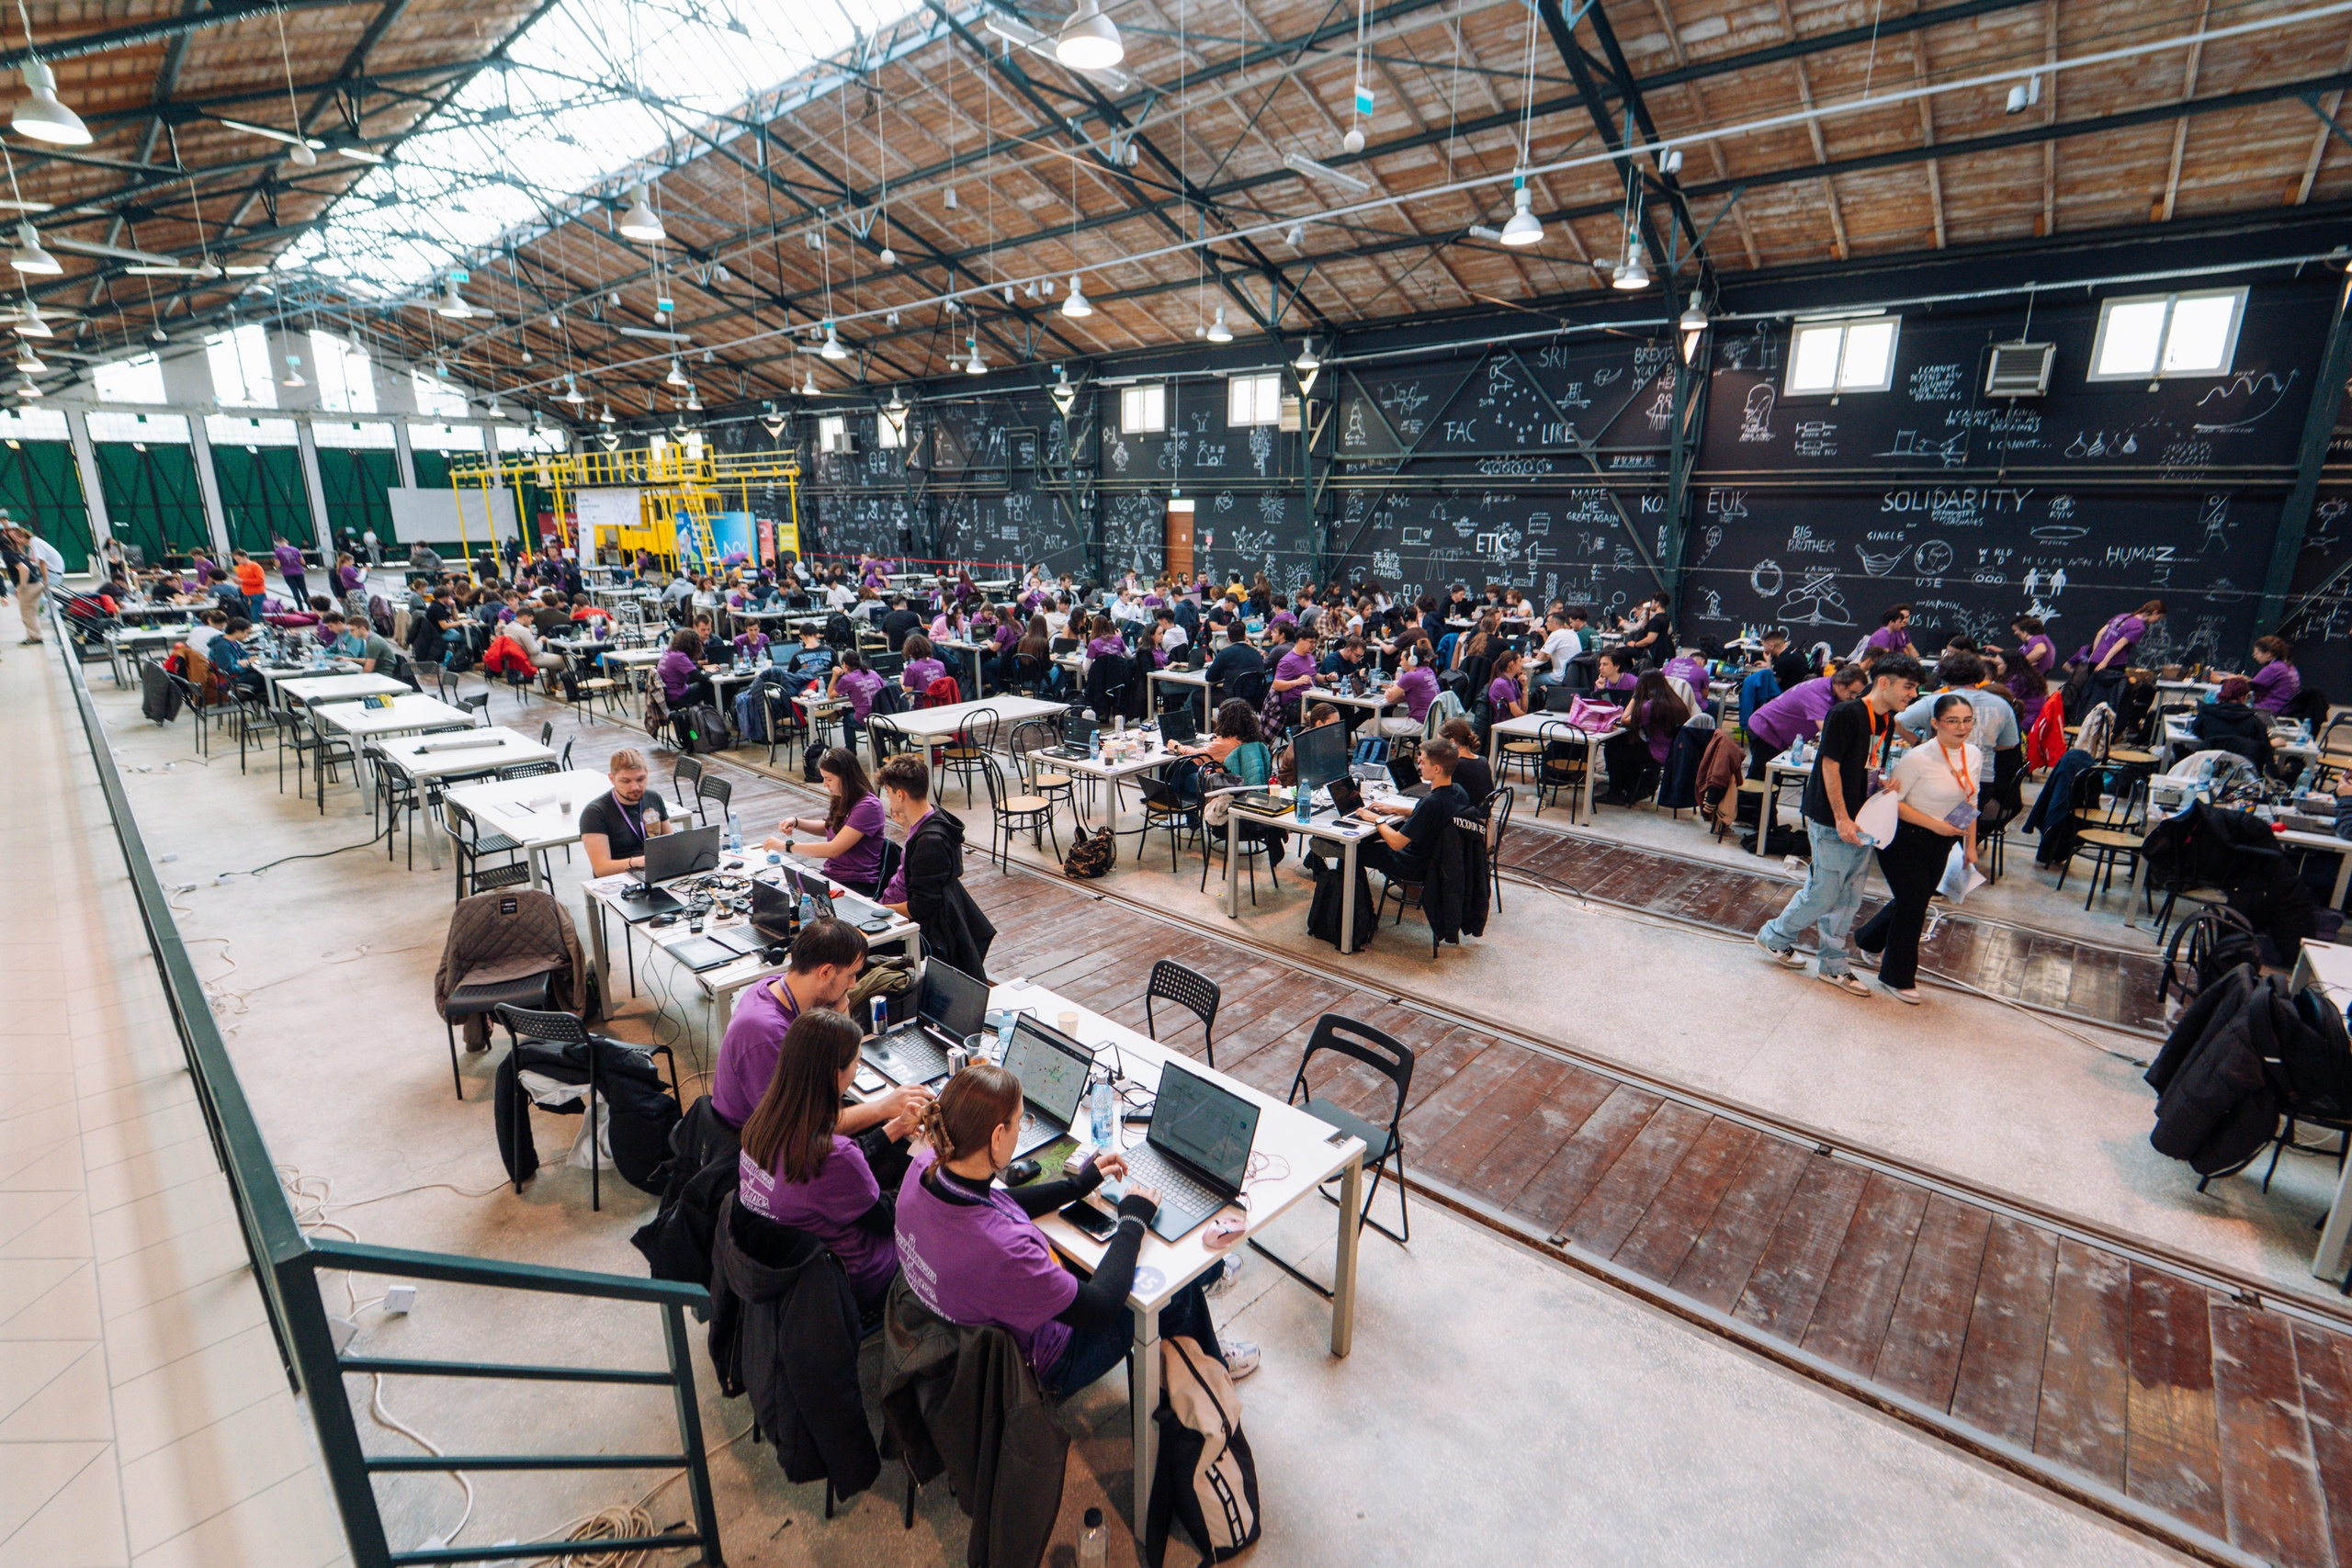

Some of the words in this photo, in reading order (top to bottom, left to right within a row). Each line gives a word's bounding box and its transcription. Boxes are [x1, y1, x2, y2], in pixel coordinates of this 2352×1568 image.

[1571, 488, 1608, 501] MAKE
[1881, 488, 2034, 513] SOLIDARITY
[1792, 525, 1813, 539] BIG
[1867, 530, 1905, 541] SINGLE
[1786, 538, 1836, 552] BROTHER
[1373, 560, 1400, 570] CHARLIE
[1916, 577, 1942, 588] USE
